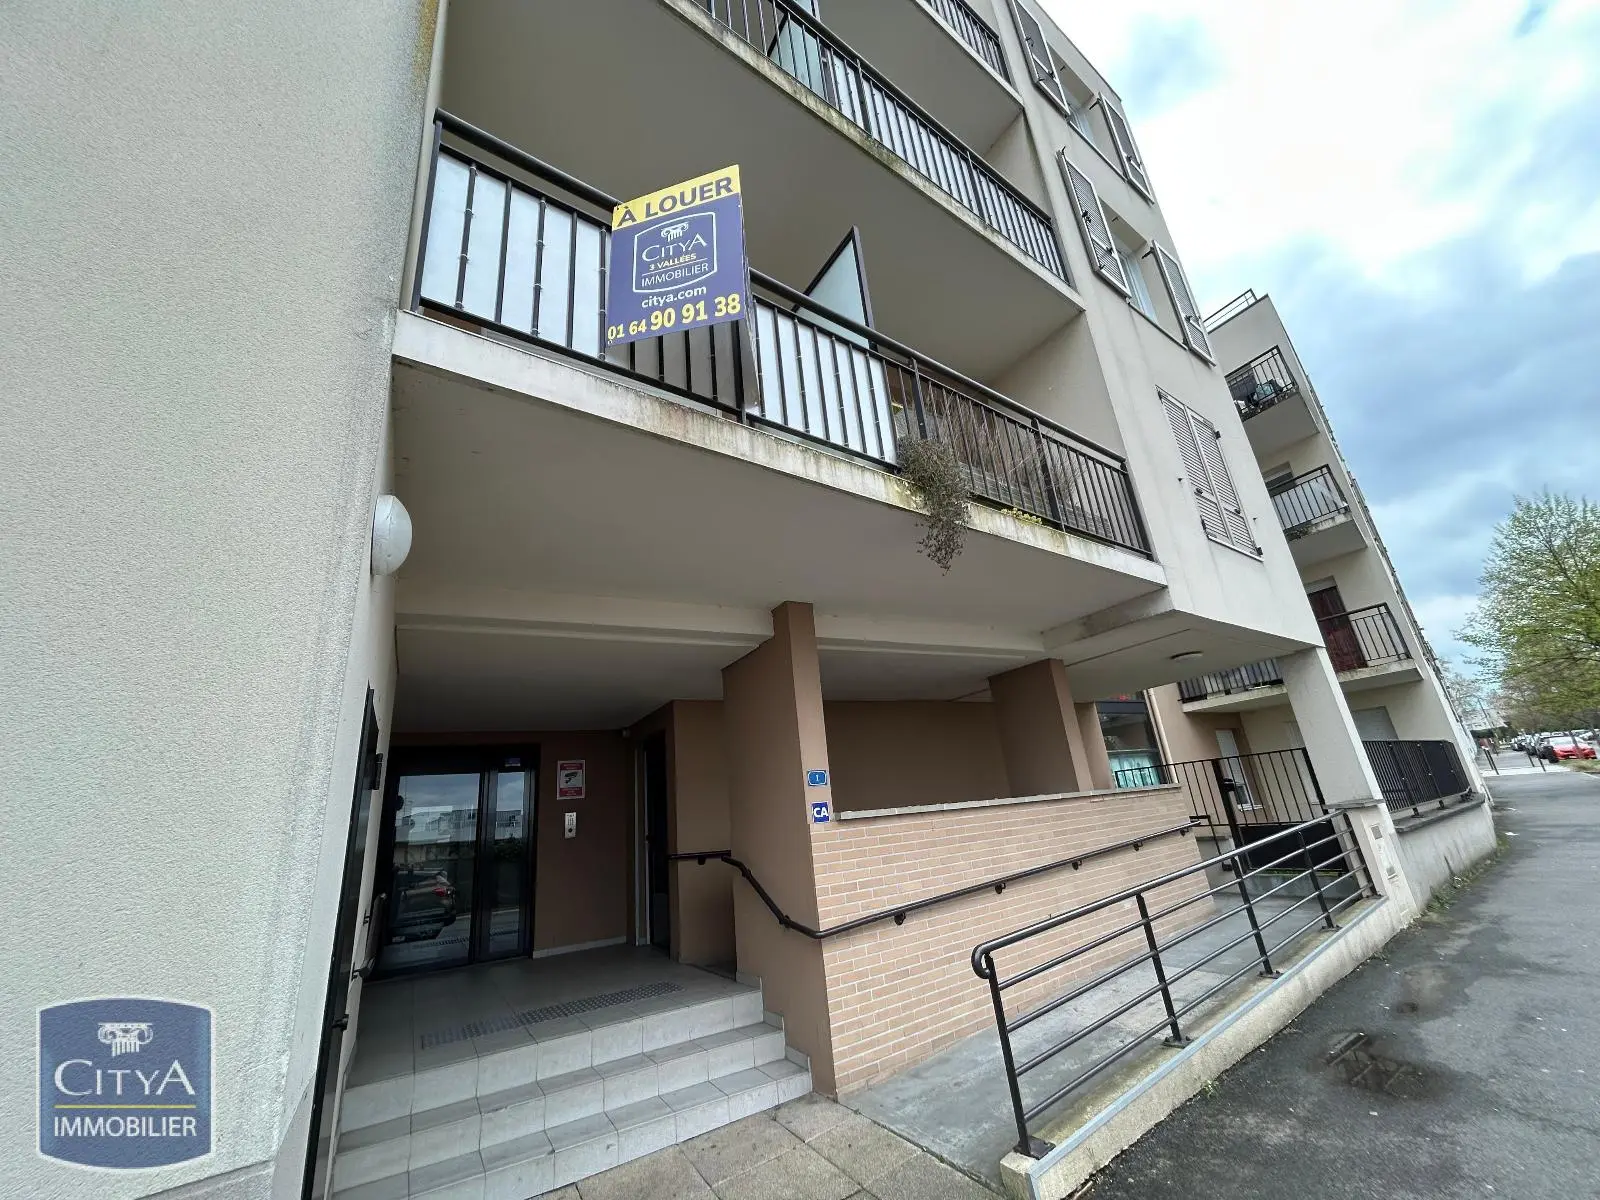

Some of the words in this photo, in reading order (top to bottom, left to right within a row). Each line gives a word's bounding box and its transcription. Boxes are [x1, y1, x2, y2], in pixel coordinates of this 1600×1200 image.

[617, 205, 637, 227] À
[645, 176, 734, 218] LOUER
[657, 252, 697, 269] VALLÉES
[641, 262, 709, 287] IMMOBILIER
[641, 285, 707, 308] citya.com
[607, 324, 625, 340] 01
[628, 319, 647, 335] 64
[650, 308, 676, 331] 90
[681, 300, 708, 324] 91
[714, 293, 741, 317] 38
[813, 806, 829, 818] CA
